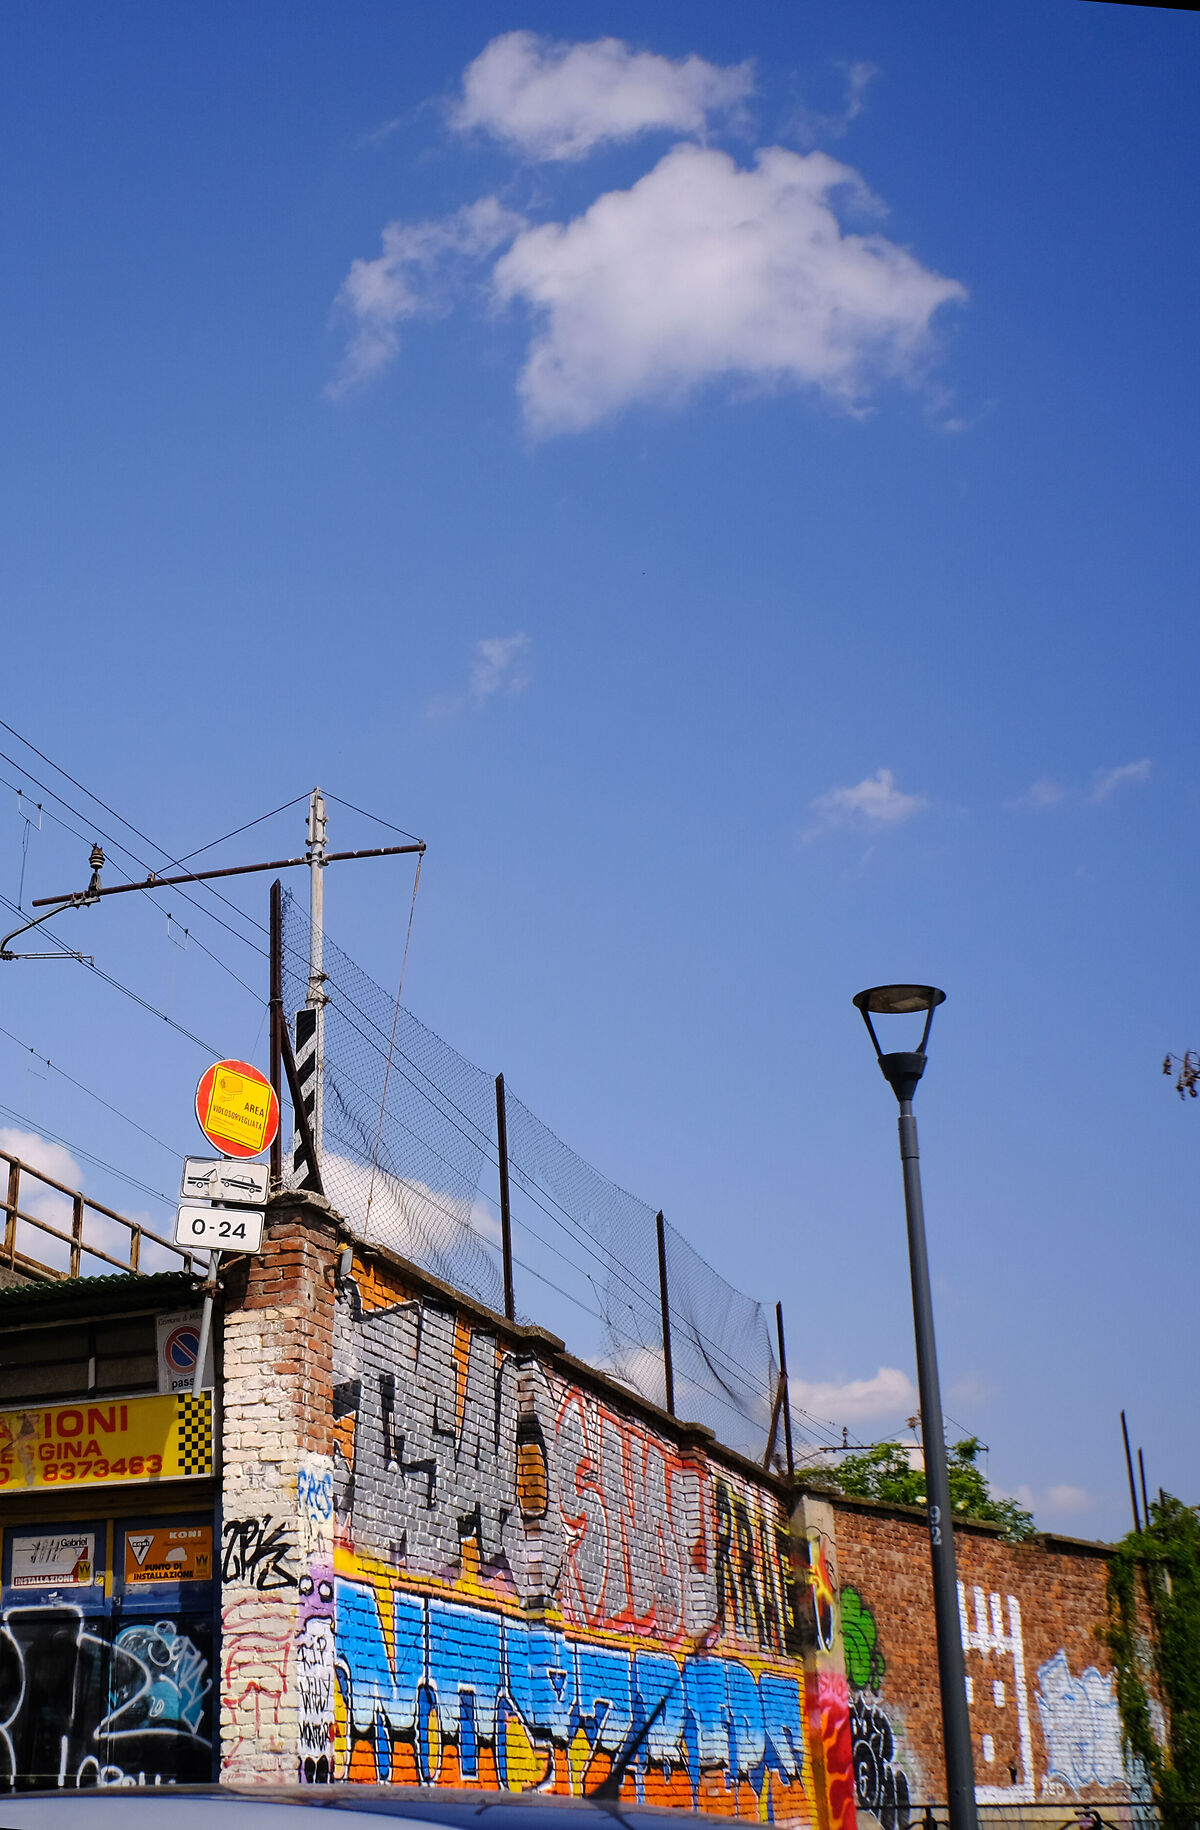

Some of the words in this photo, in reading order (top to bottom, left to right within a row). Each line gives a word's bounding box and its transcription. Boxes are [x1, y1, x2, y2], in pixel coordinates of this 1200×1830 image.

[244, 1102, 265, 1118] AREA
[213, 1104, 262, 1130] VIDEOSORVEGLIATA
[172, 1377, 195, 1391] pass
[43, 1454, 163, 1482] 8373463
[169, 1530, 202, 1539] KONI
[60, 1537, 88, 1547] Gabriel
[145, 1563, 171, 1571] PUNTO
[173, 1562, 182, 1570] DI
[15, 1574, 74, 1585] INSTALLAZIONE
[133, 1571, 194, 1580] INSTALLAZIONE
